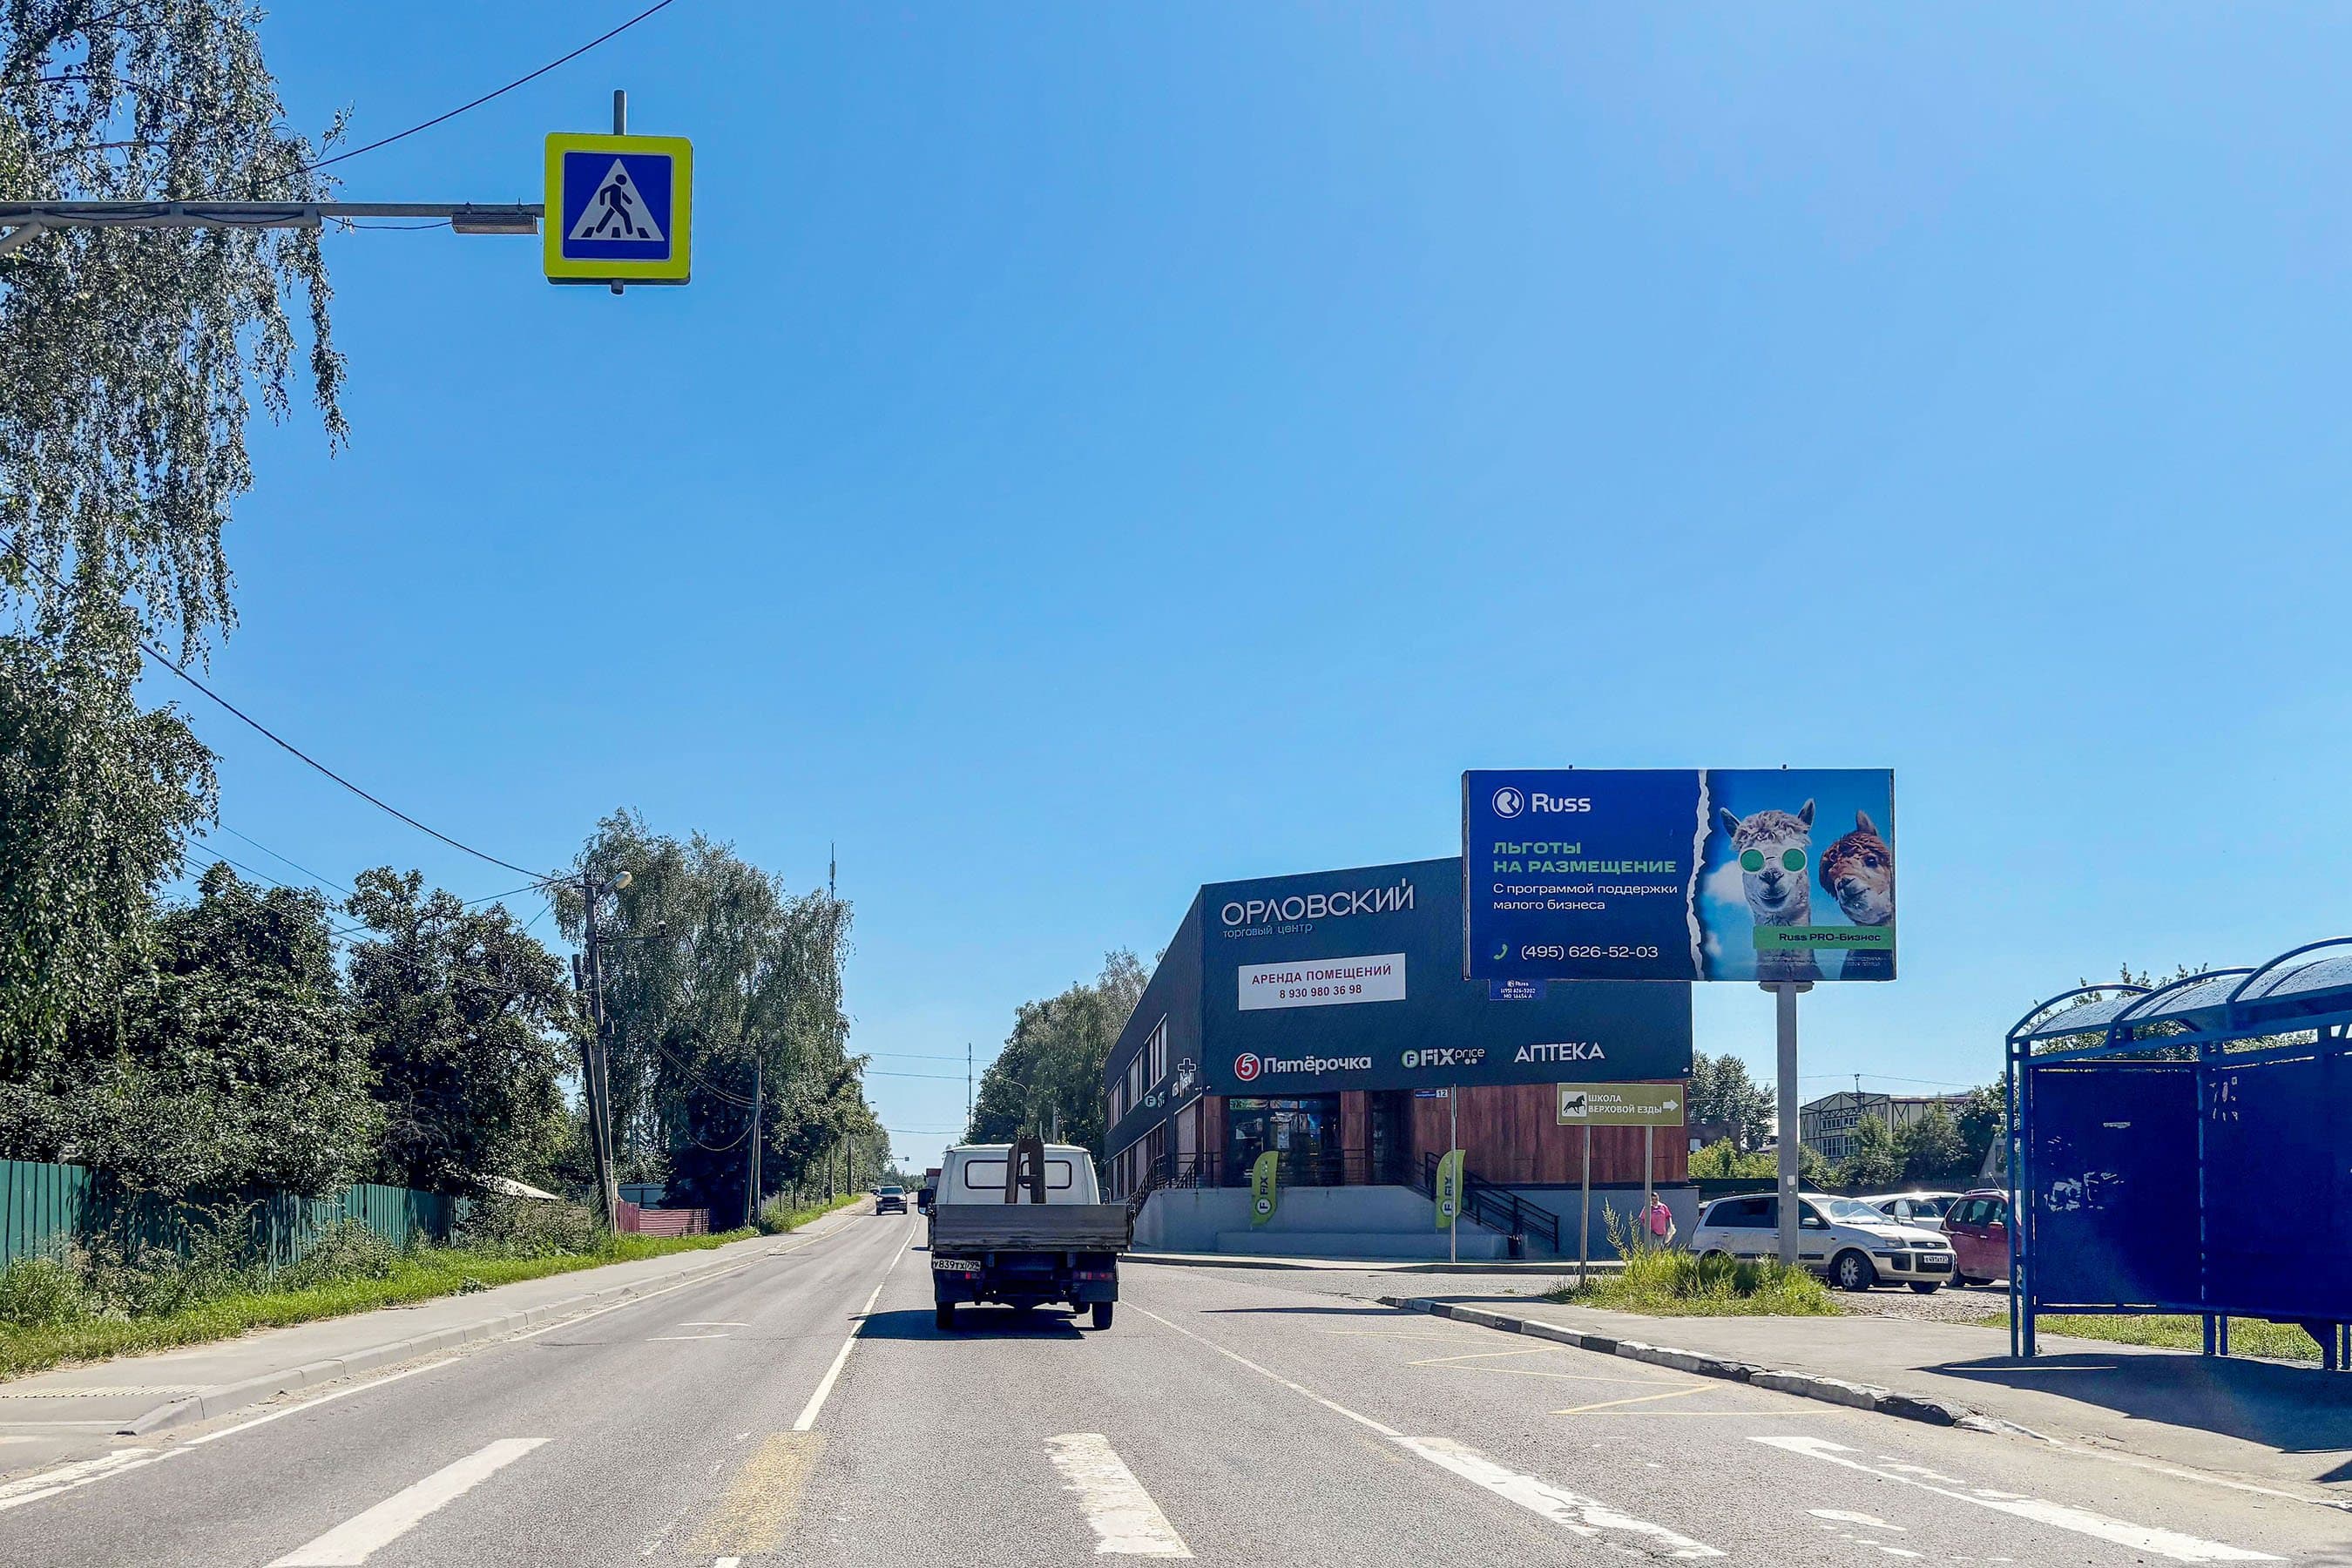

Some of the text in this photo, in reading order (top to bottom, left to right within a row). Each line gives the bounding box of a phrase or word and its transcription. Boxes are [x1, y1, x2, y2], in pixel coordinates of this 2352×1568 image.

[1531, 792, 1592, 814] Russ
[1492, 841, 1582, 855] ЛЬГОТЫ
[1492, 860, 1677, 875] НА РАЗМЕЩЕНИЕ
[1492, 882, 1679, 898] С программой поддержки
[1220, 877, 1415, 926] ОРЛОВСКИЙ
[1493, 898, 1606, 911] малого бизнеса
[1222, 923, 1314, 940] торговый центр
[1779, 931, 1882, 943] Russ PRO-Бизнес
[1520, 944, 1659, 961] (495) 626-52-03
[1251, 963, 1392, 986] АРЕНДА ПОМЕЩЕНИЙ
[1279, 983, 1362, 999] 8 930 980 36 98
[1455, 1048, 1485, 1060] price
[1513, 1041, 1605, 1064] АПТЕКА
[1239, 1055, 1373, 1078] 5 Пятёрочка
[1588, 1094, 1622, 1103] ШКОЛА
[1588, 1104, 1662, 1115] ВЕРХОВОЙ ЕЗДЫ
